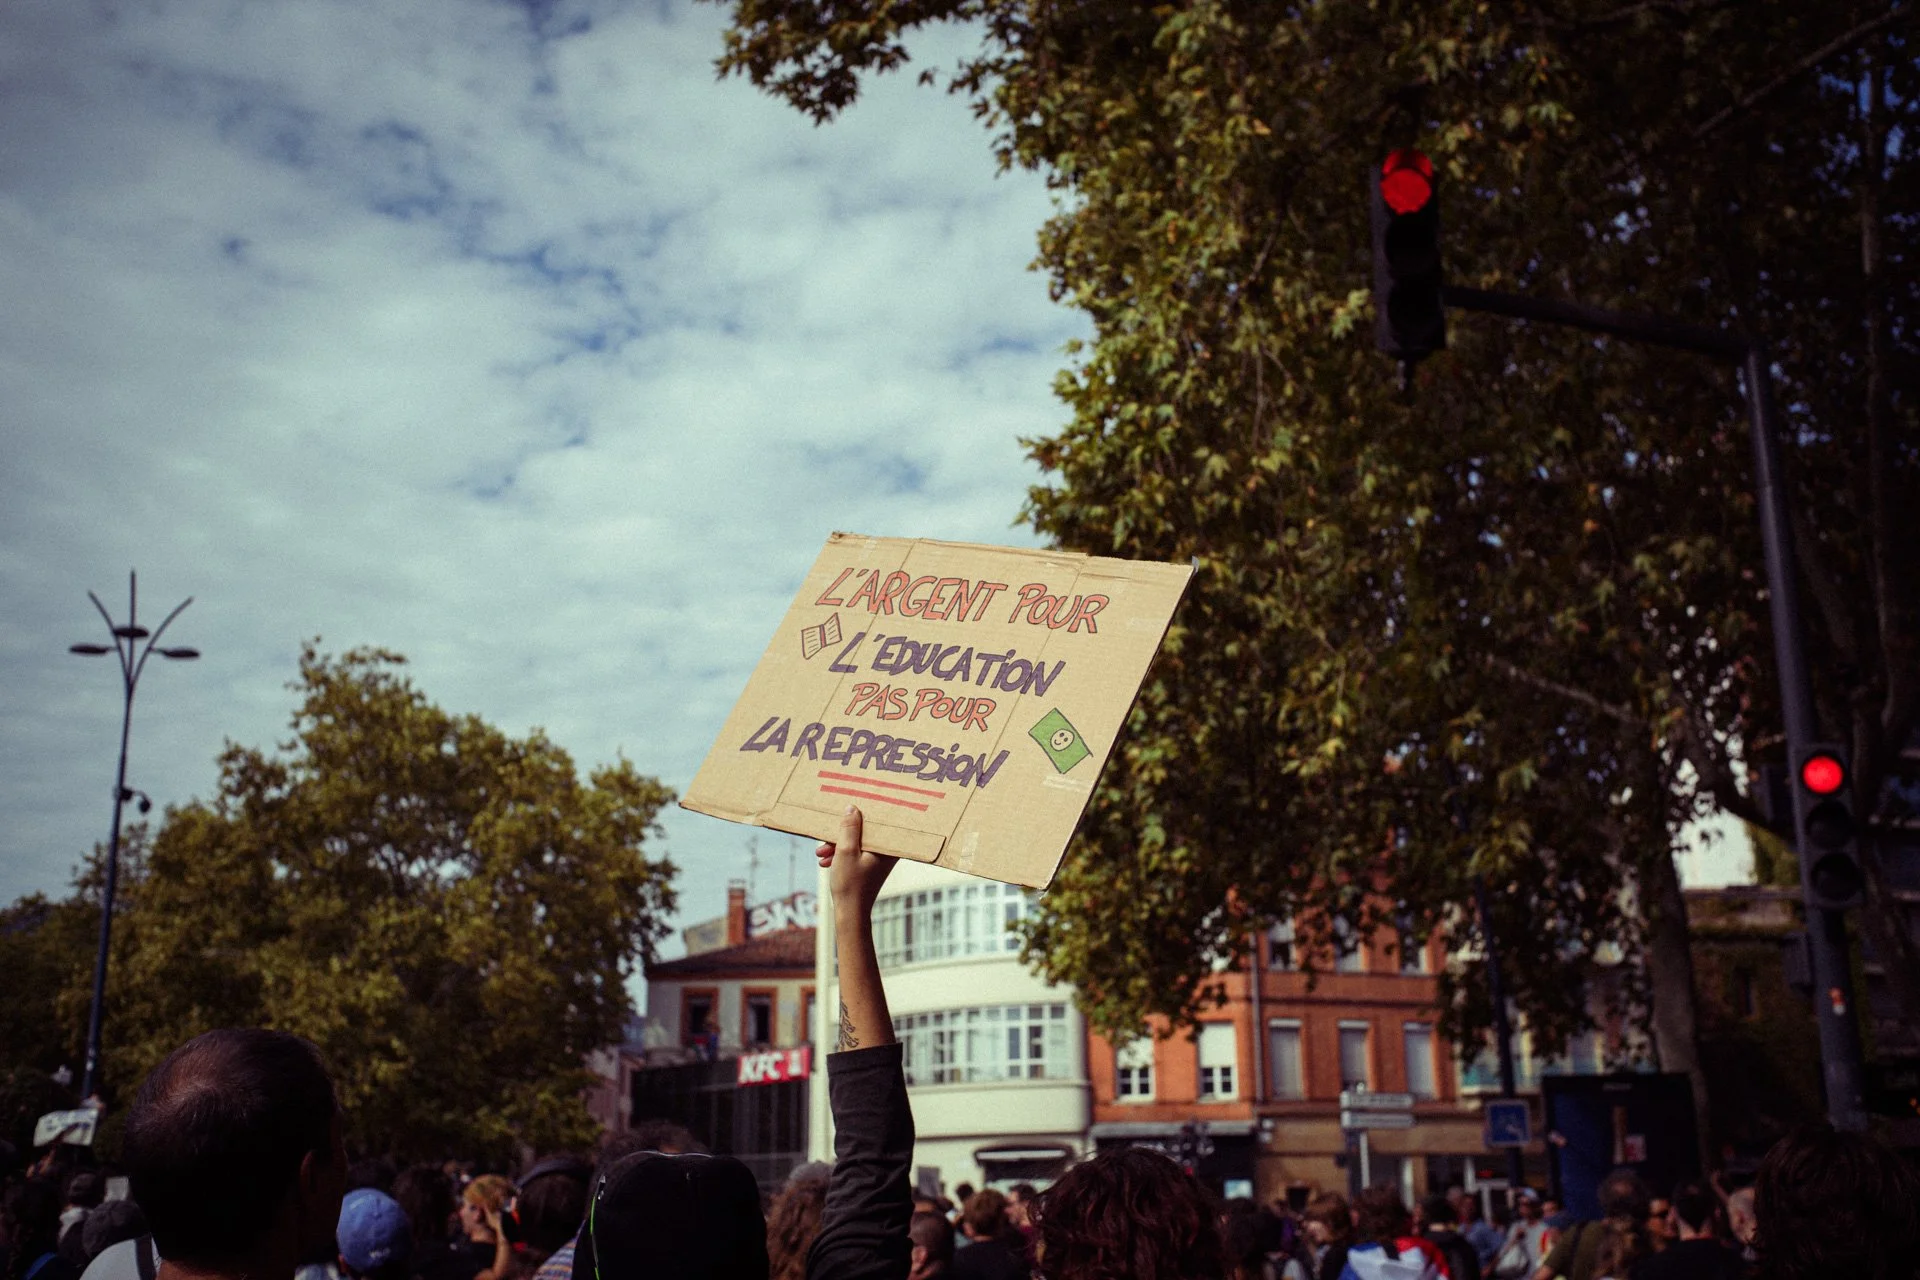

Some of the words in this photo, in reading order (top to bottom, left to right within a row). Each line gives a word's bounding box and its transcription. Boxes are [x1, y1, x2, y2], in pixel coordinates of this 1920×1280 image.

[815, 567, 1008, 622] L'ARGENT
[1008, 583, 1110, 633] POUR
[844, 683, 908, 721] PAS
[909, 688, 997, 732] POUR
[739, 716, 791, 753] LA
[739, 1052, 784, 1083] KFC
